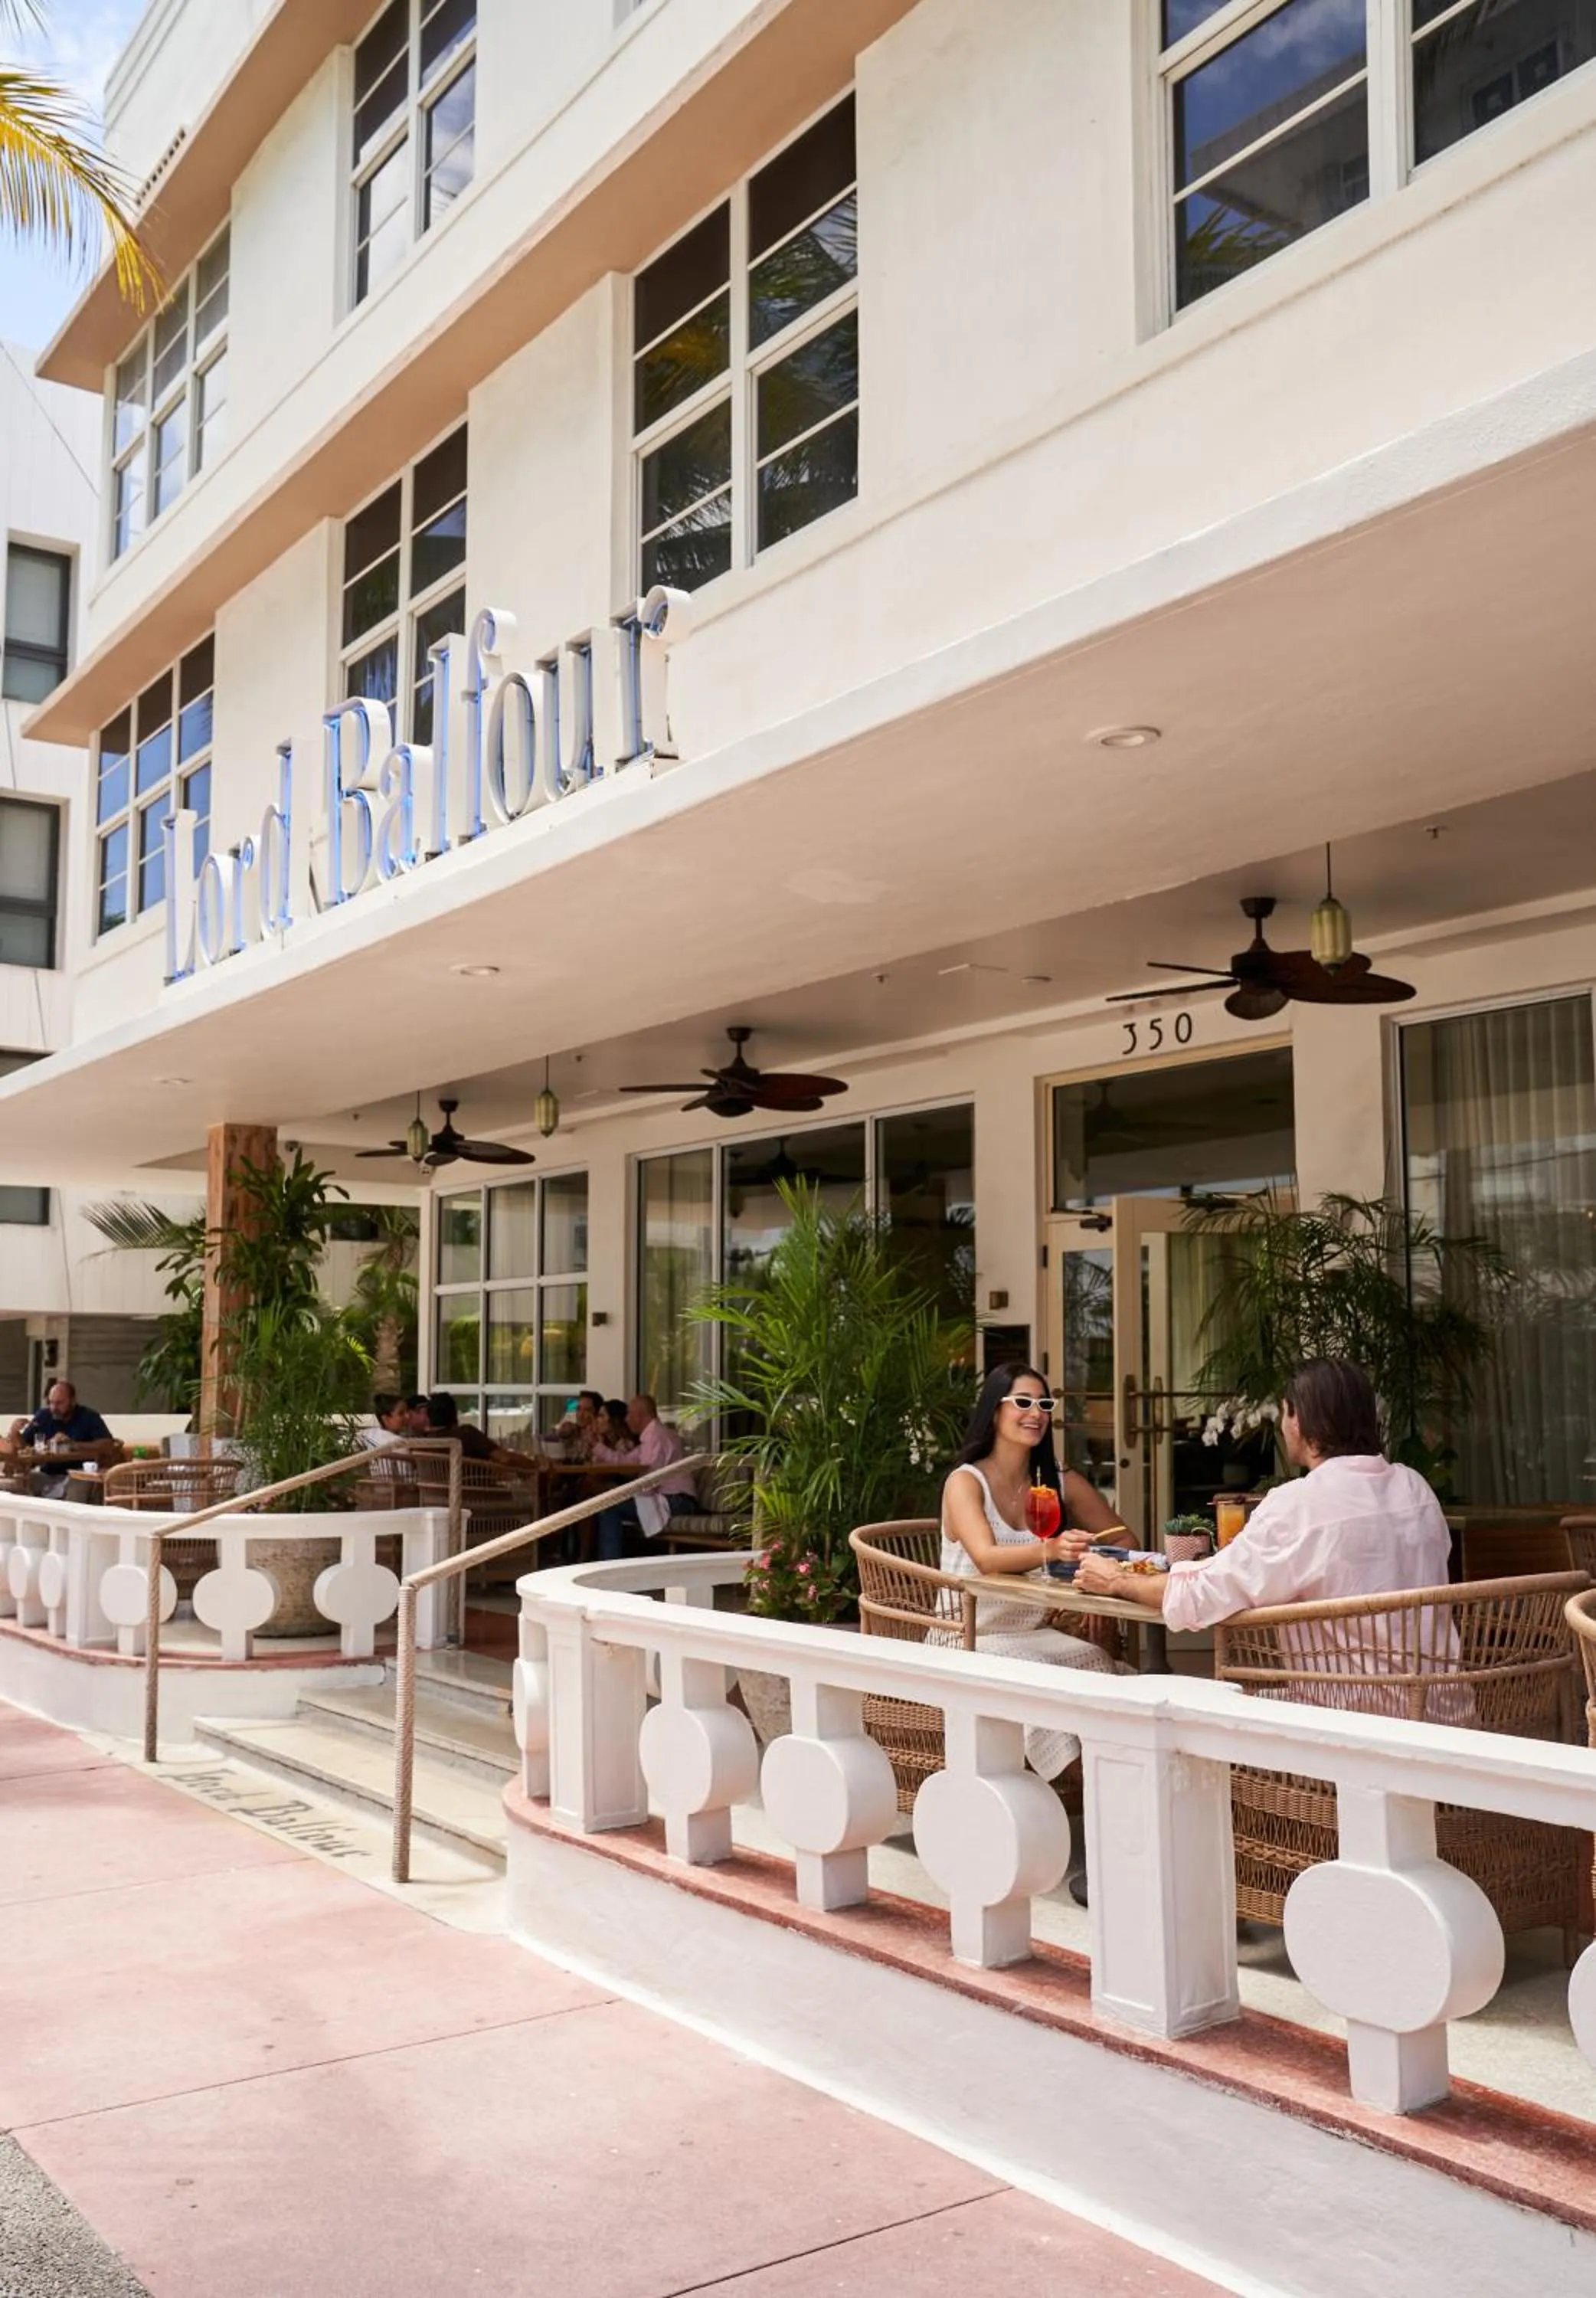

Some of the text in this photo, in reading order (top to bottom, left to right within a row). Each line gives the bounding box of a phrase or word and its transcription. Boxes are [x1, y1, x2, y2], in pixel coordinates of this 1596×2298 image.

[162, 584, 691, 987] Lord Balfour
[1122, 1012, 1192, 1055] 350
[156, 1769, 371, 1858] Lord Balfour
